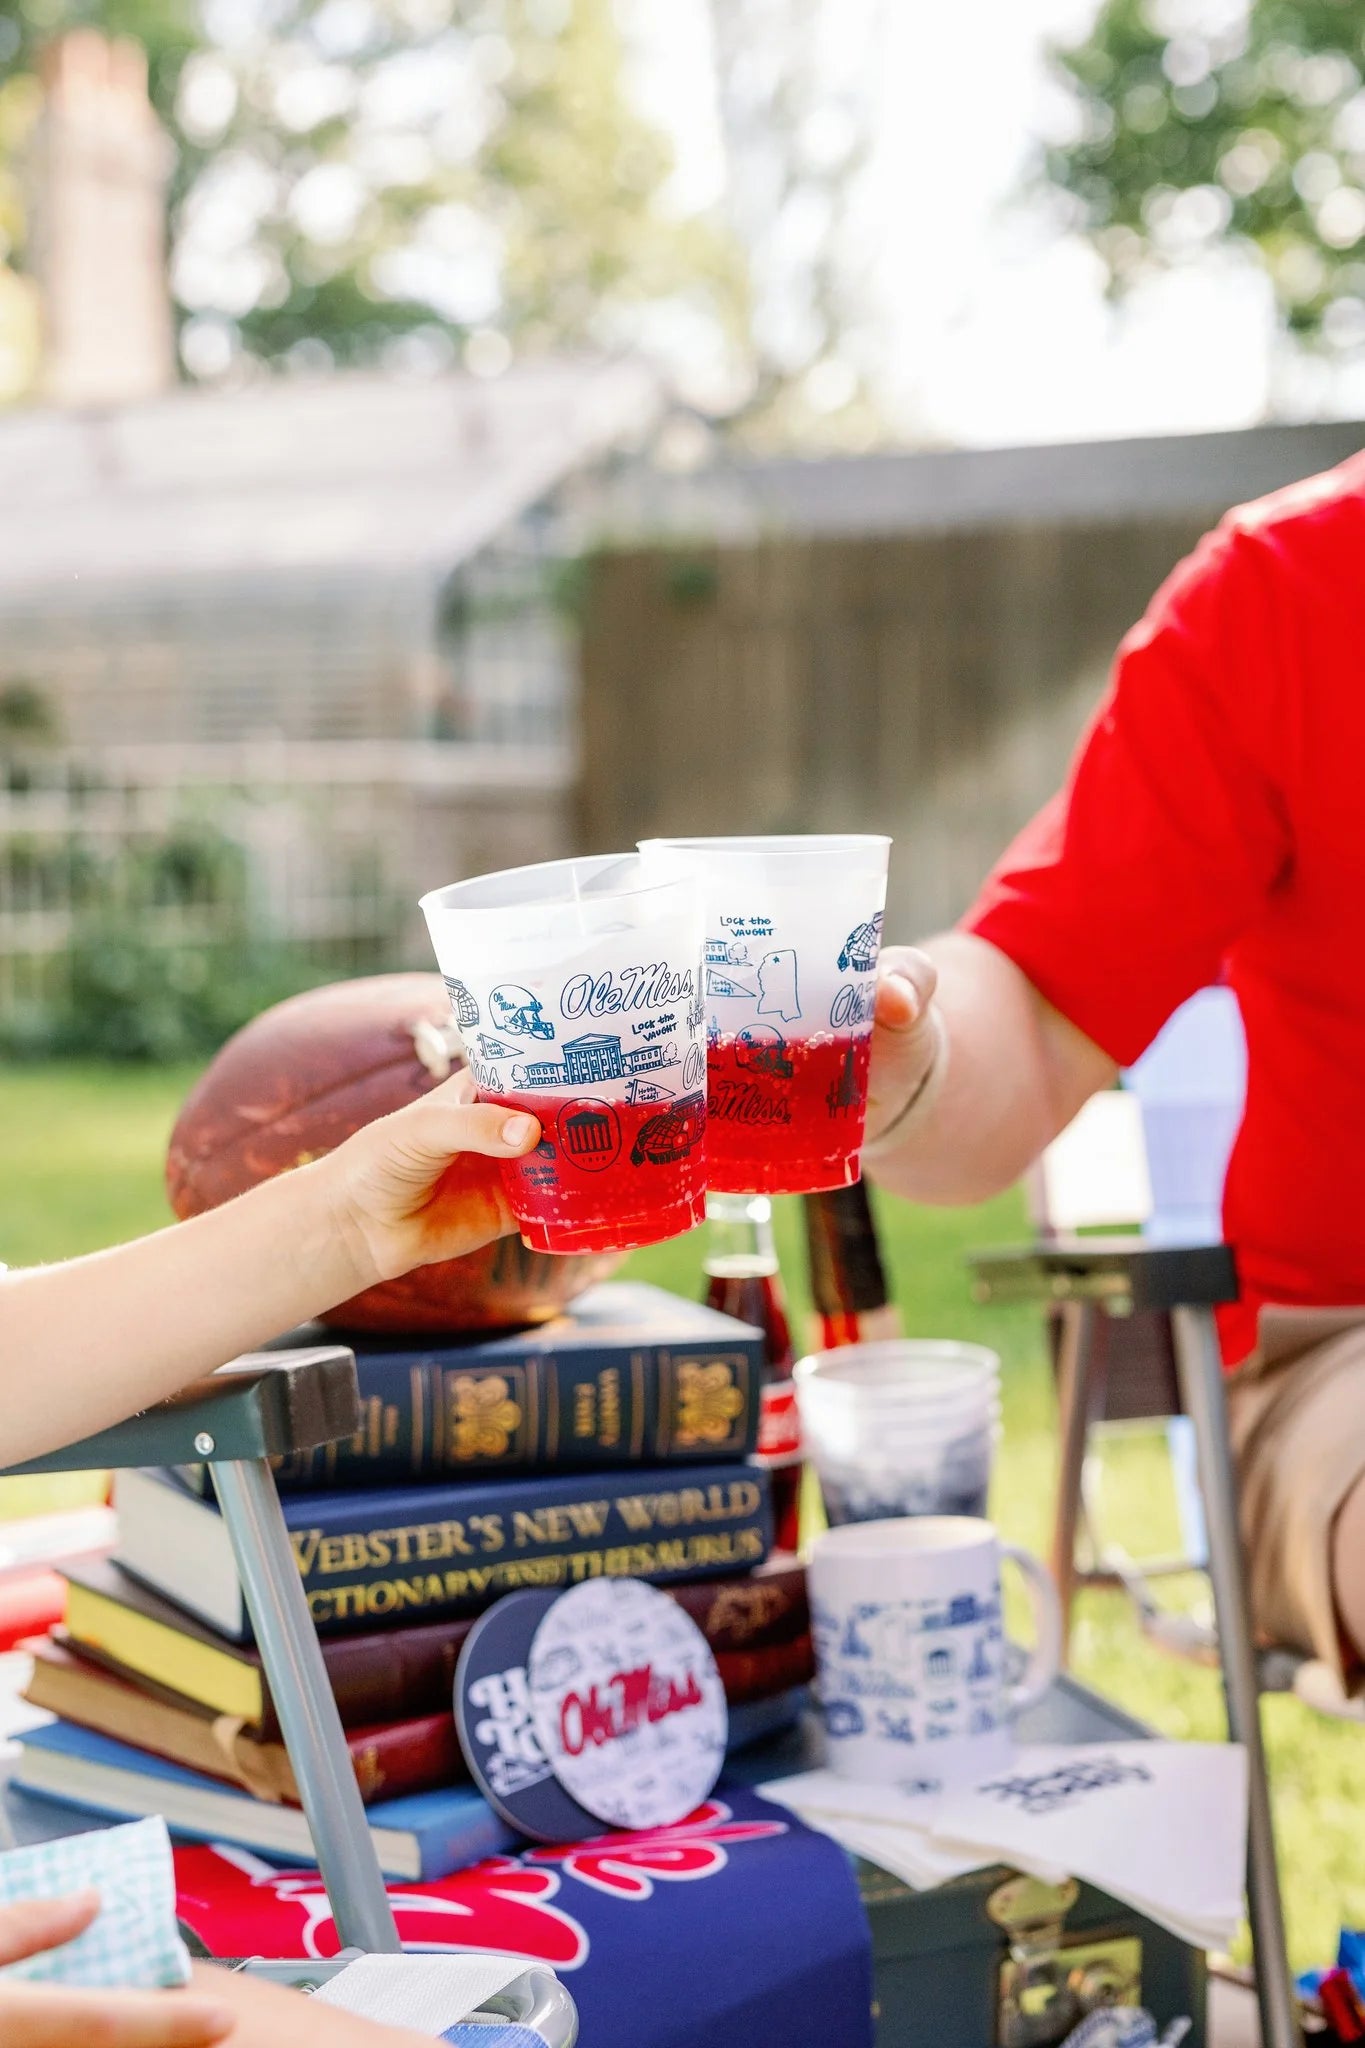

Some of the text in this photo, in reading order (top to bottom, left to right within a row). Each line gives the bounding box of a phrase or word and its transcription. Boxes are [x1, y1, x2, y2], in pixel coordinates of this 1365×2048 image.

[720, 916, 772, 926] Lock the
[730, 928, 773, 937] VAUGHT
[631, 1013, 675, 1035] Lock the
[642, 1022, 678, 1042] VAUGHT
[512, 1500, 610, 1546] NEW
[615, 1480, 761, 1532] WORLD
[306, 1564, 496, 1623] CTIONARY
